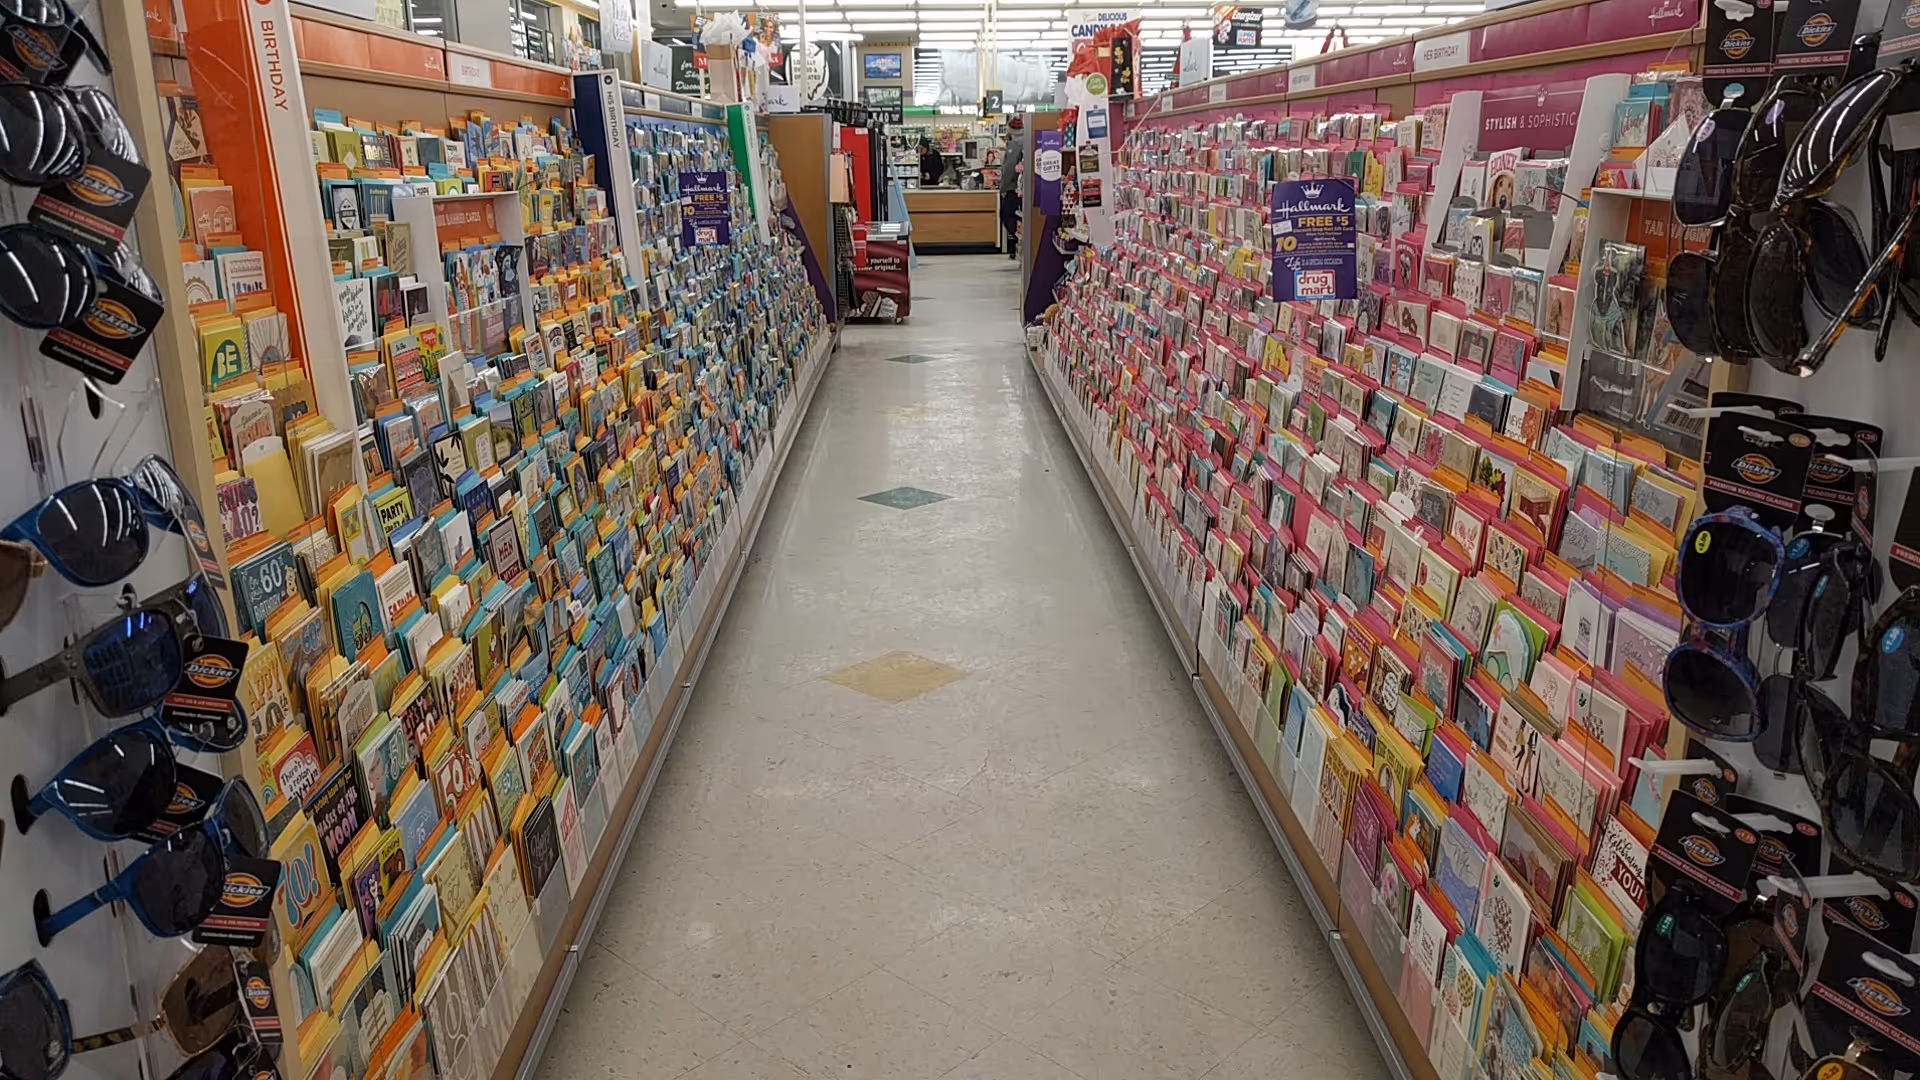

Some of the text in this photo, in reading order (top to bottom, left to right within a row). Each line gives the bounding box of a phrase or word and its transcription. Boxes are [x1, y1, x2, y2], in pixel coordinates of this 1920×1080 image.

[1098, 13, 1127, 21] DELICIOUS
[1801, 24, 1833, 35] Dickies
[14, 28, 58, 65] Dickies
[1723, 40, 1751, 48] Dickies
[261, 20, 288, 111] BIRTHDAY
[991, 96, 999, 108] 2
[609, 107, 620, 149] BIRTHDAY
[1485, 117, 1517, 130] STYLISH
[1520, 116, 1525, 128] &
[77, 175, 126, 199] ickies
[682, 183, 725, 196] Hallmark
[467, 211, 480, 222] CARDS
[683, 206, 695, 216] 10
[1275, 198, 1351, 219] Hallmark
[1298, 216, 1334, 228] FREE
[1645, 220, 1665, 236] TAIL
[1276, 236, 1297, 252] 10
[870, 257, 892, 265] yourself
[1298, 271, 1328, 286] drug
[1301, 285, 1335, 296] mart
[217, 345, 238, 379] BE
[1737, 461, 1776, 477] Dickies
[1709, 480, 1794, 509] PREMIUM READING GLASSES
[380, 500, 404, 524] PARTY
[187, 663, 234, 678] Dickies
[281, 759, 302, 786] There's
[325, 806, 359, 859] MOON
[1608, 832, 1644, 881] Celebrating
[1684, 840, 1720, 862] Dickies
[1617, 863, 1643, 903] YOU!
[1657, 849, 1735, 896] PREMIUM READING GLASSES
[1852, 901, 1885, 925] Dickies
[1855, 981, 1904, 1012] Dickies
[1819, 987, 1854, 1012] PREMIUM
[1855, 1009, 1890, 1034] READING
